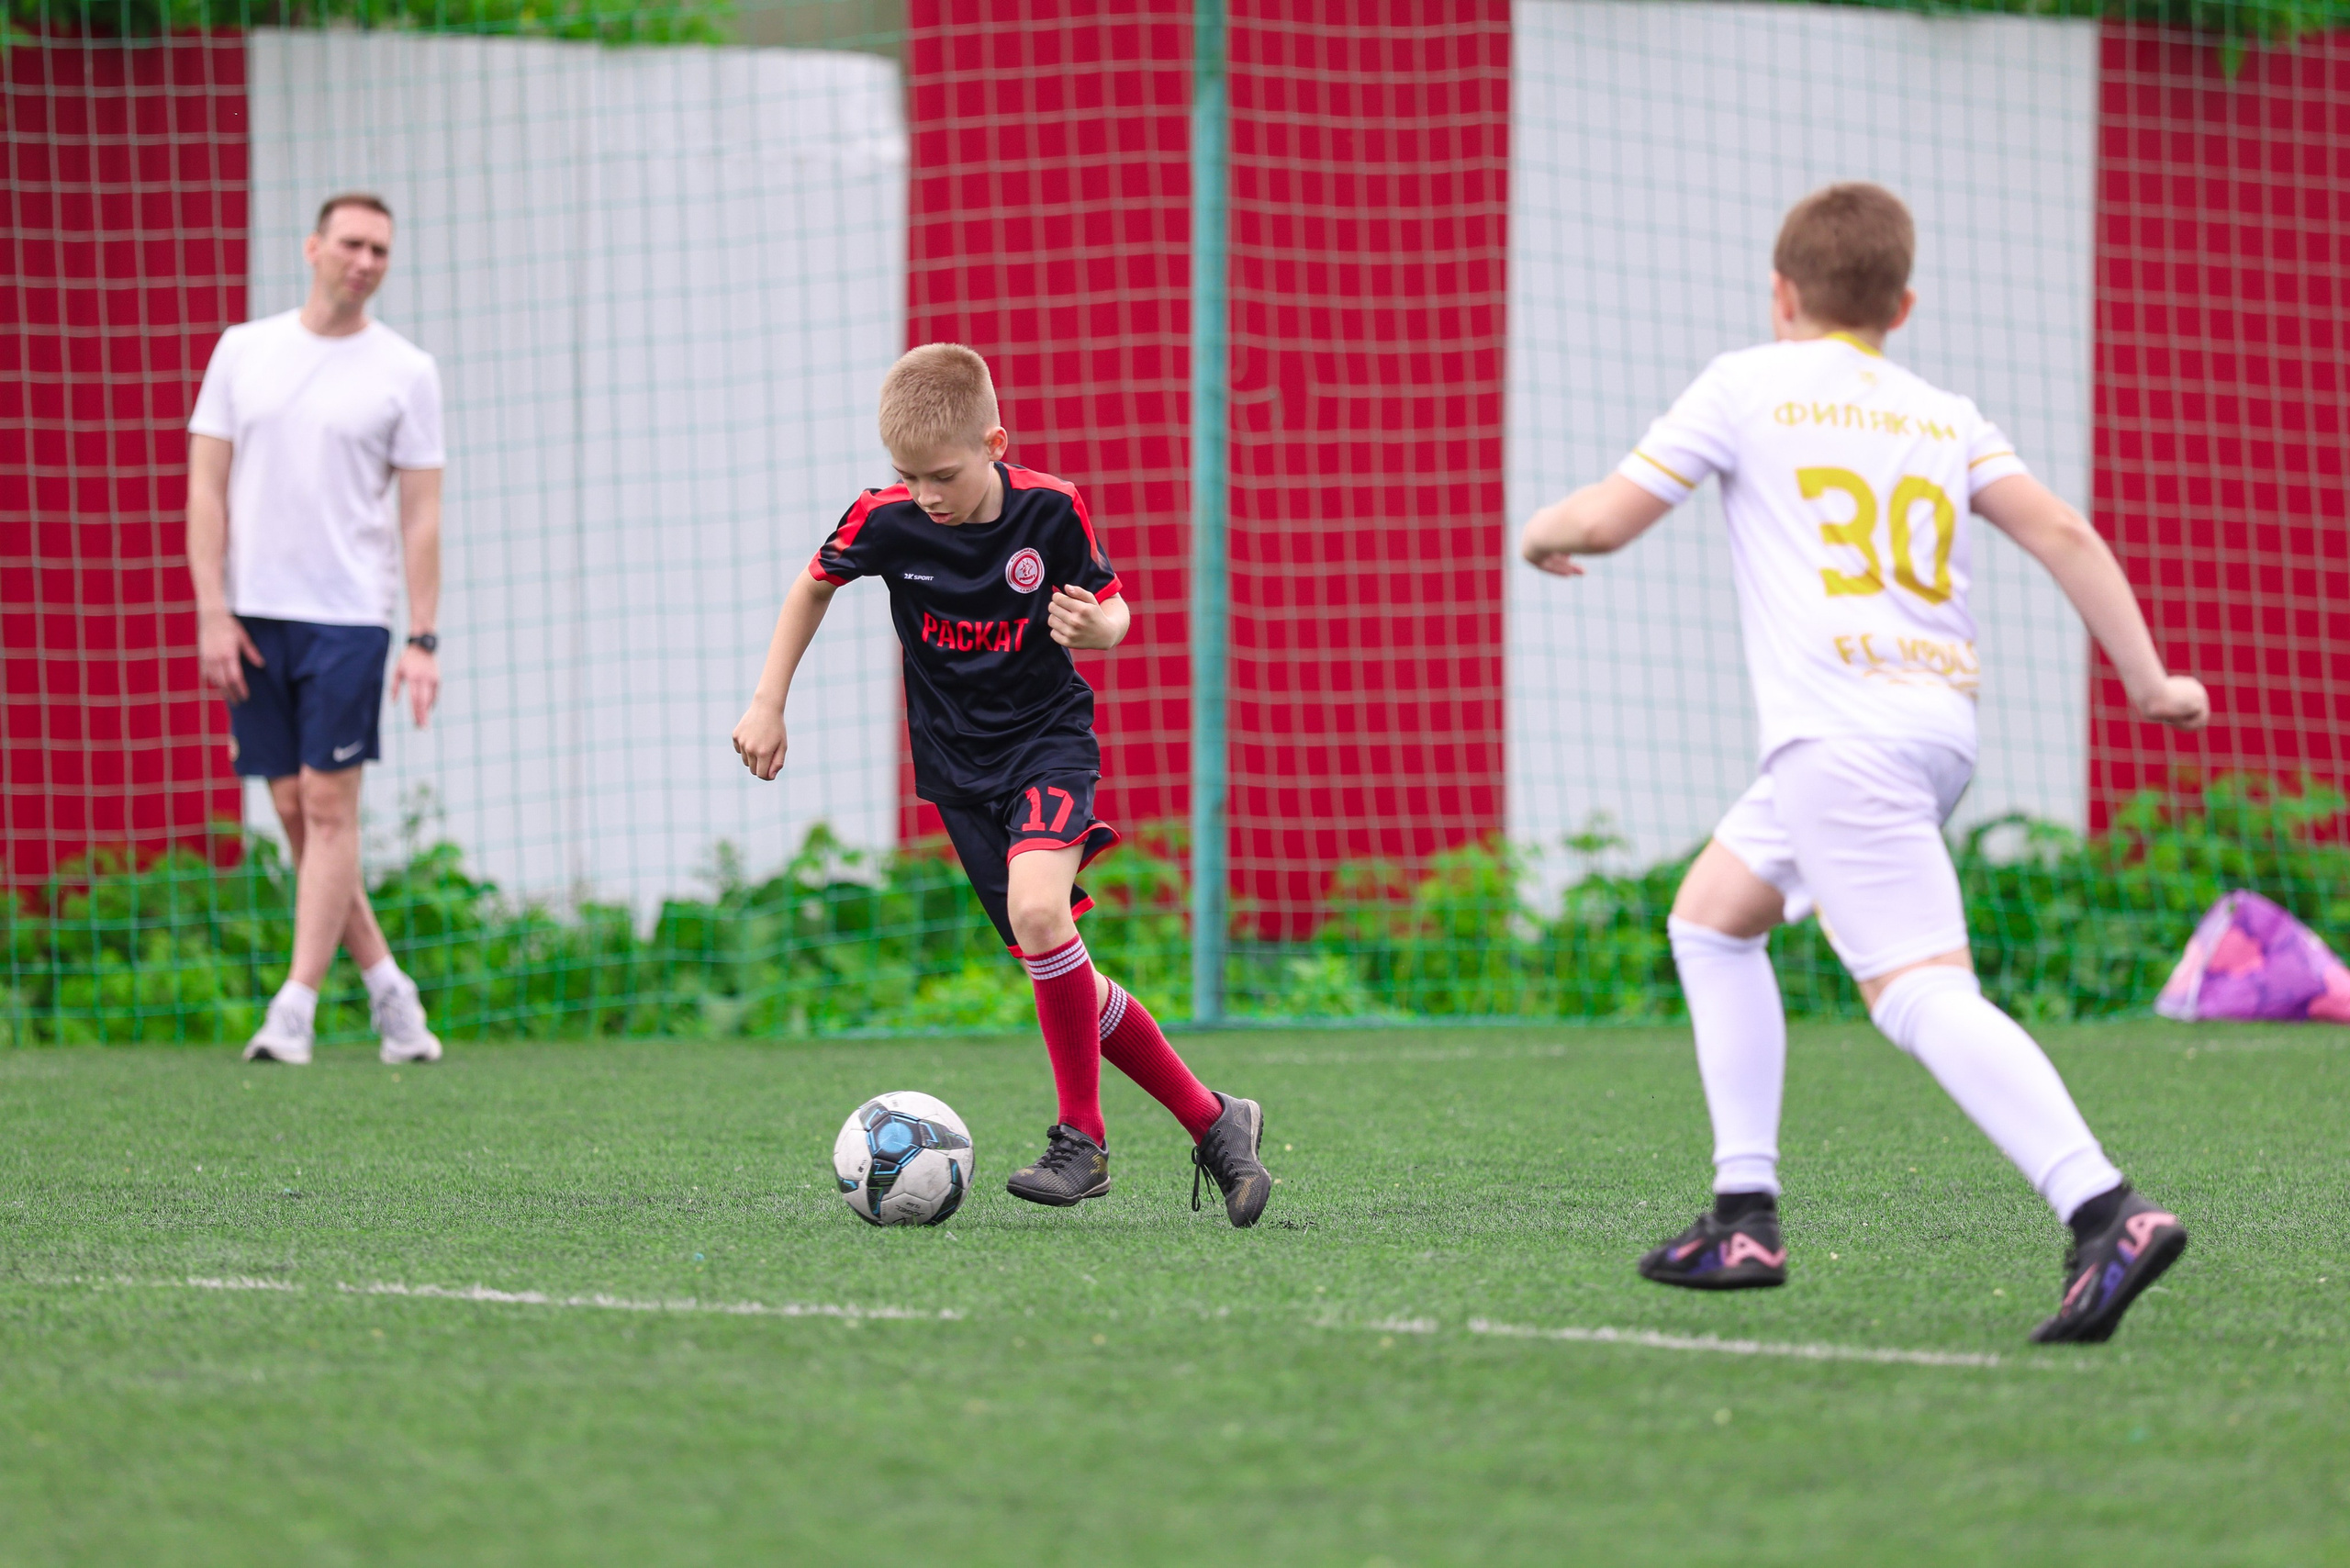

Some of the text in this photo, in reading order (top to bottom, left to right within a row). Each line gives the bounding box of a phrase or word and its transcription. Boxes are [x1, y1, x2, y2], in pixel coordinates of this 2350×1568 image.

[1796, 466, 1956, 606] 30
[922, 611, 1030, 652] РАСКАТ
[1022, 786, 1074, 833] 17
